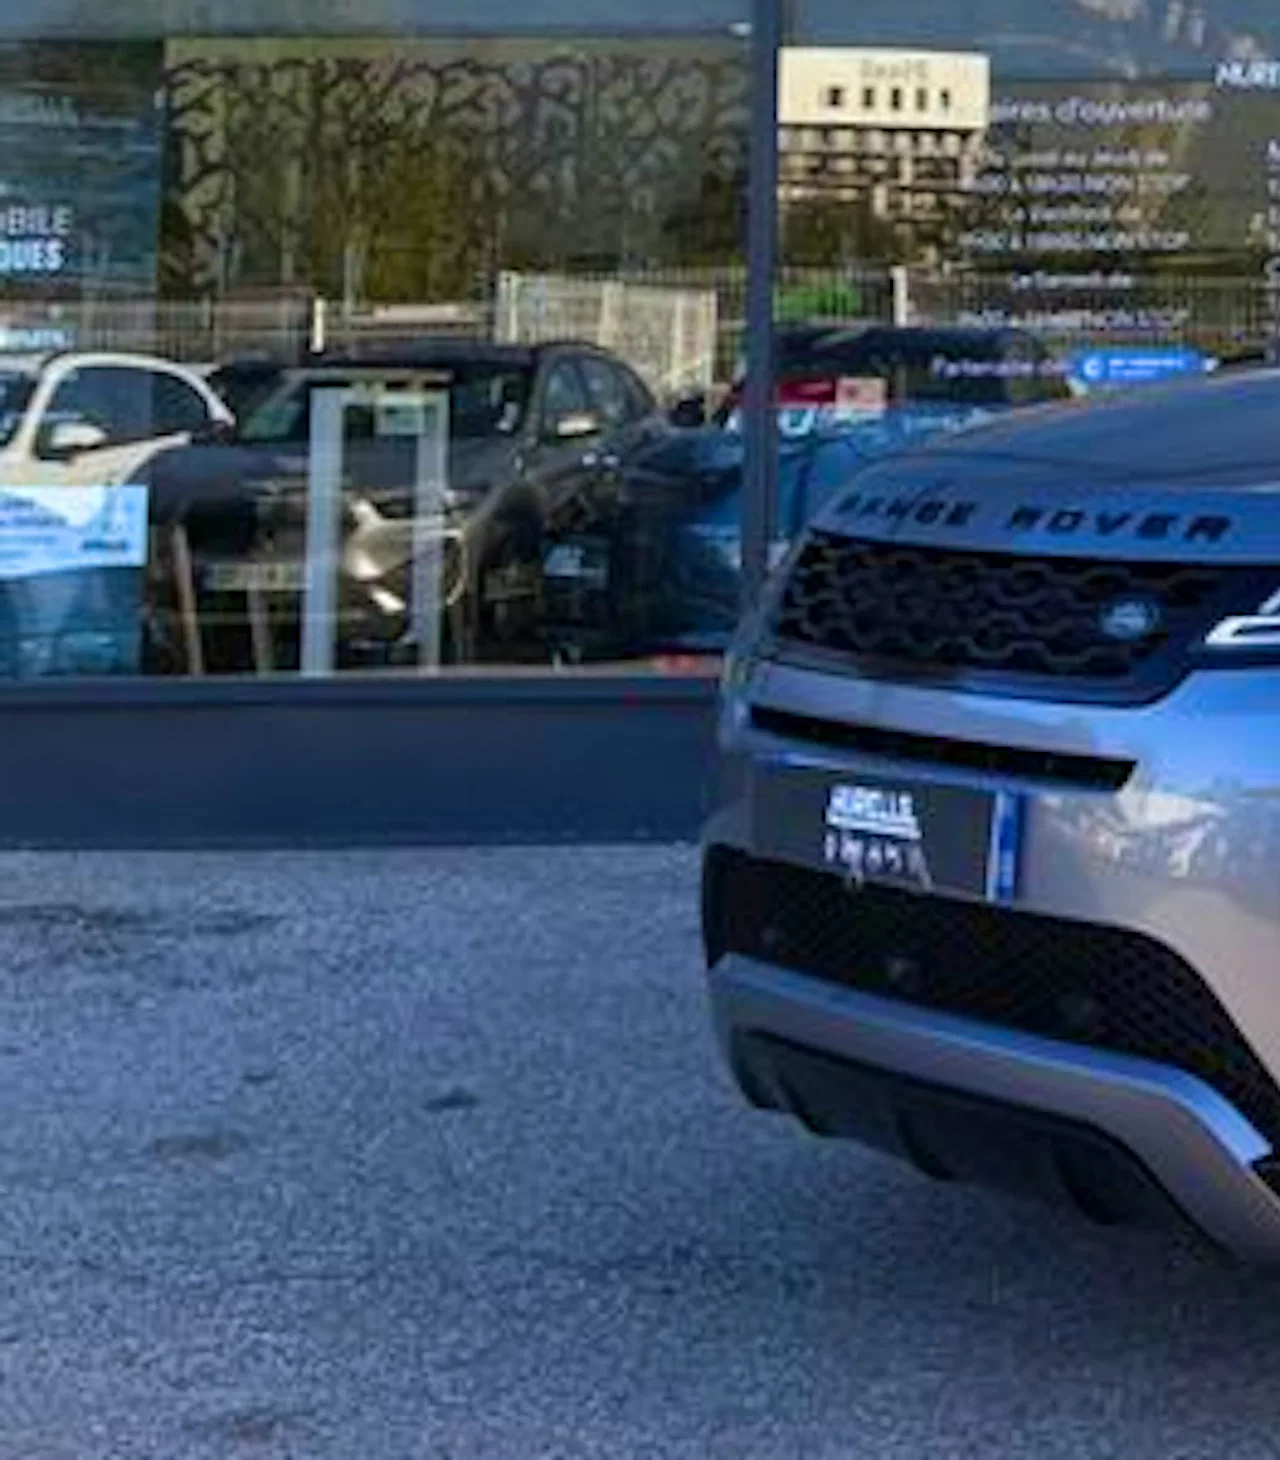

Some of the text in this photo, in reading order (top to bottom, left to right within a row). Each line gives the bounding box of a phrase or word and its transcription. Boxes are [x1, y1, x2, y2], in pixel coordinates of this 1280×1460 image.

[0, 206, 73, 236] BILE
[836, 492, 1231, 542] RANGE ROVER
